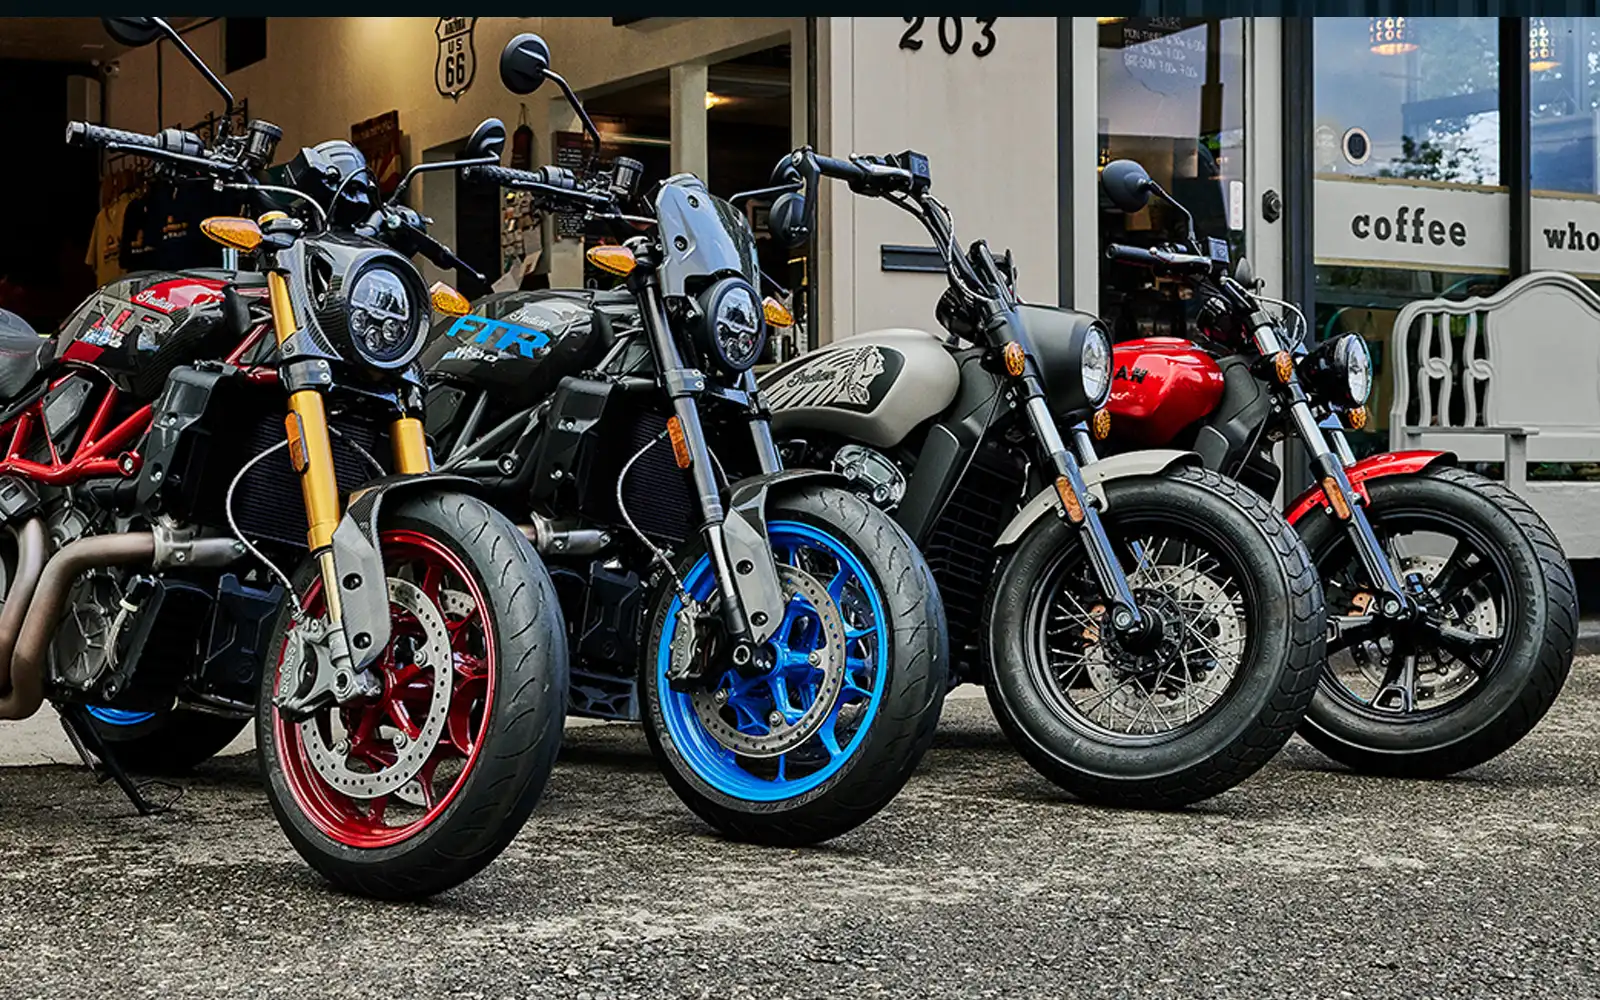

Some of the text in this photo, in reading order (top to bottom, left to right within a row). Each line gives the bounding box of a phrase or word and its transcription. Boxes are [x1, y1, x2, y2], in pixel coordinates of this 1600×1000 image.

[448, 38, 463, 54] US
[899, 16, 997, 58] 203
[446, 52, 465, 88] 66
[1351, 206, 1467, 247] coffee
[1543, 222, 1600, 251] who
[136, 289, 176, 312] Indian
[509, 303, 551, 330] Indian
[446, 314, 552, 359] FTR
[786, 368, 838, 389] Indian
